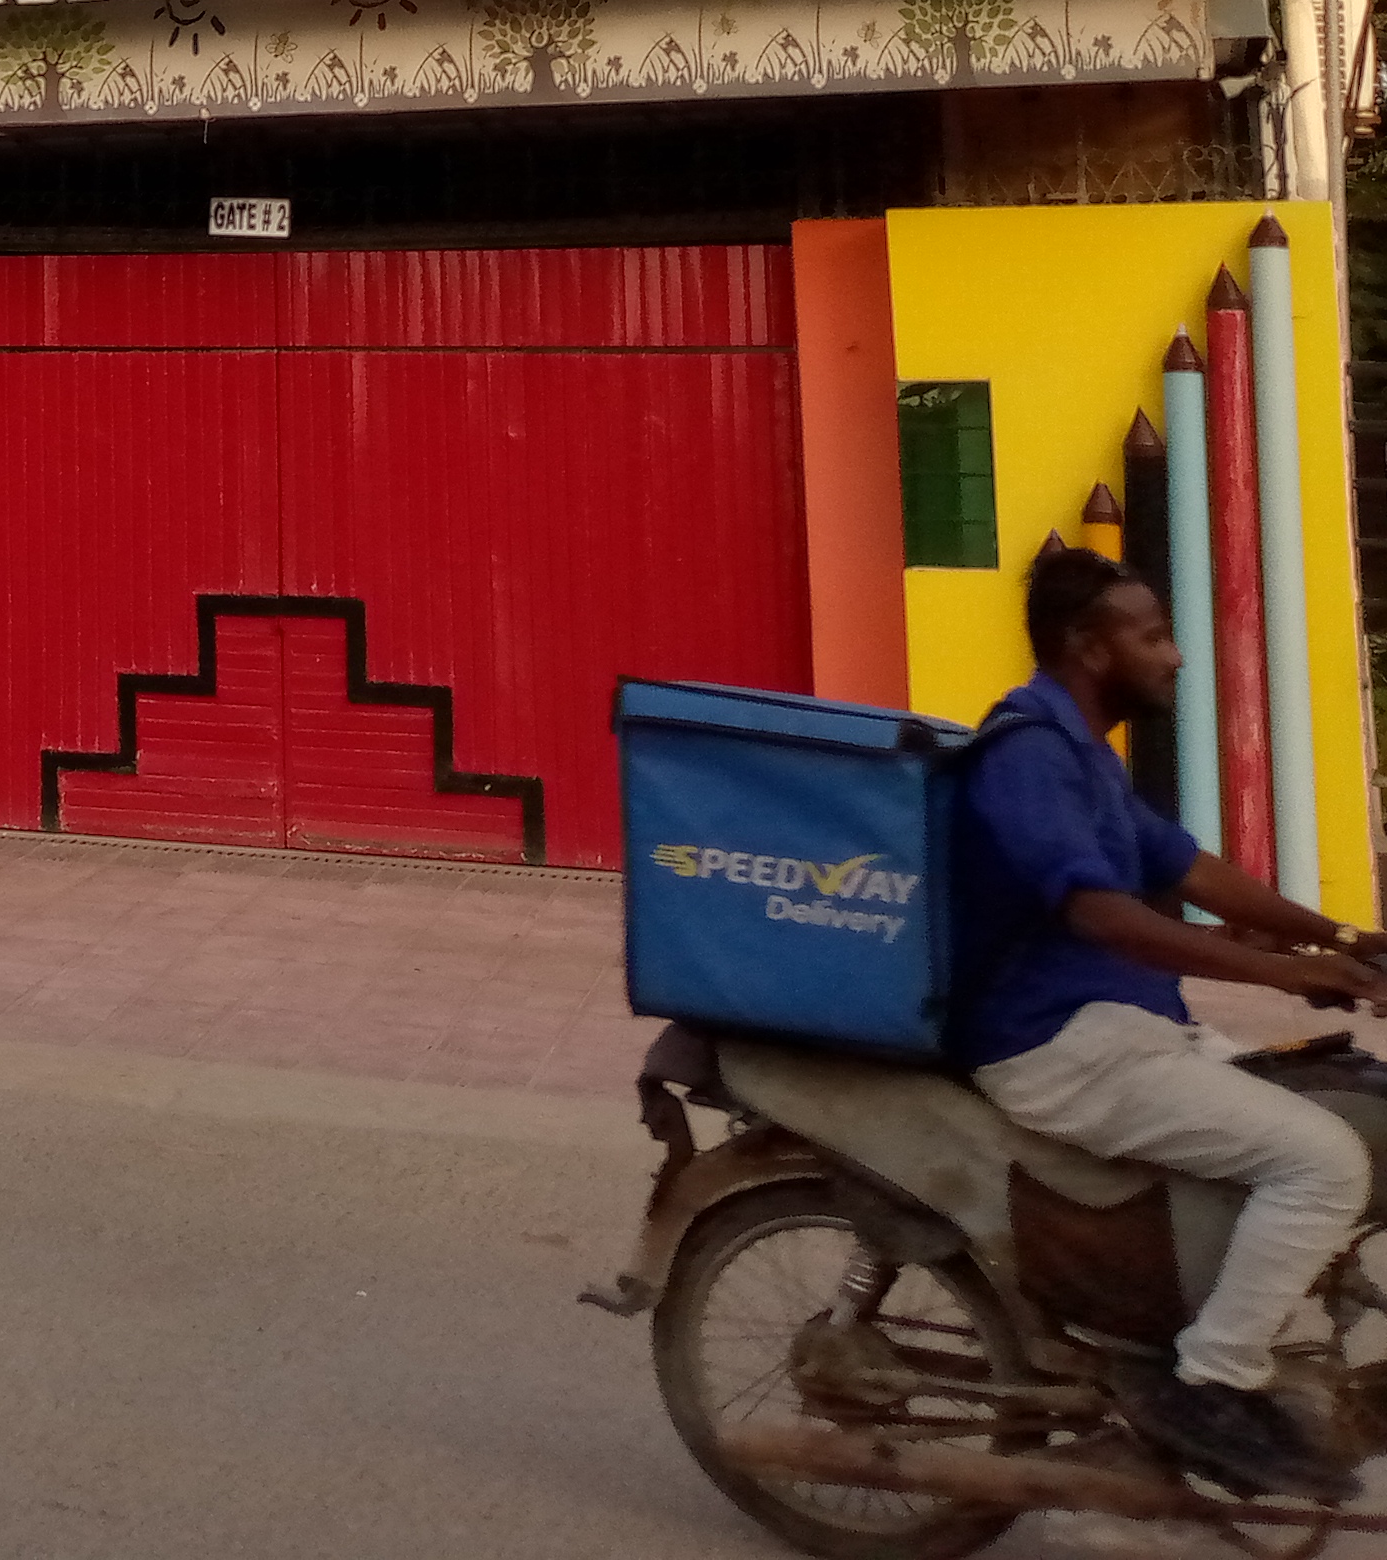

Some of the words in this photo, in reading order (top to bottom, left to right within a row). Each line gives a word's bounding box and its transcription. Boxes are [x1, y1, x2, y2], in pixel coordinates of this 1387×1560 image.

[214, 201, 257, 231] GATE
[276, 203, 287, 232] 2
[650, 843, 920, 904] SPEEDWAY
